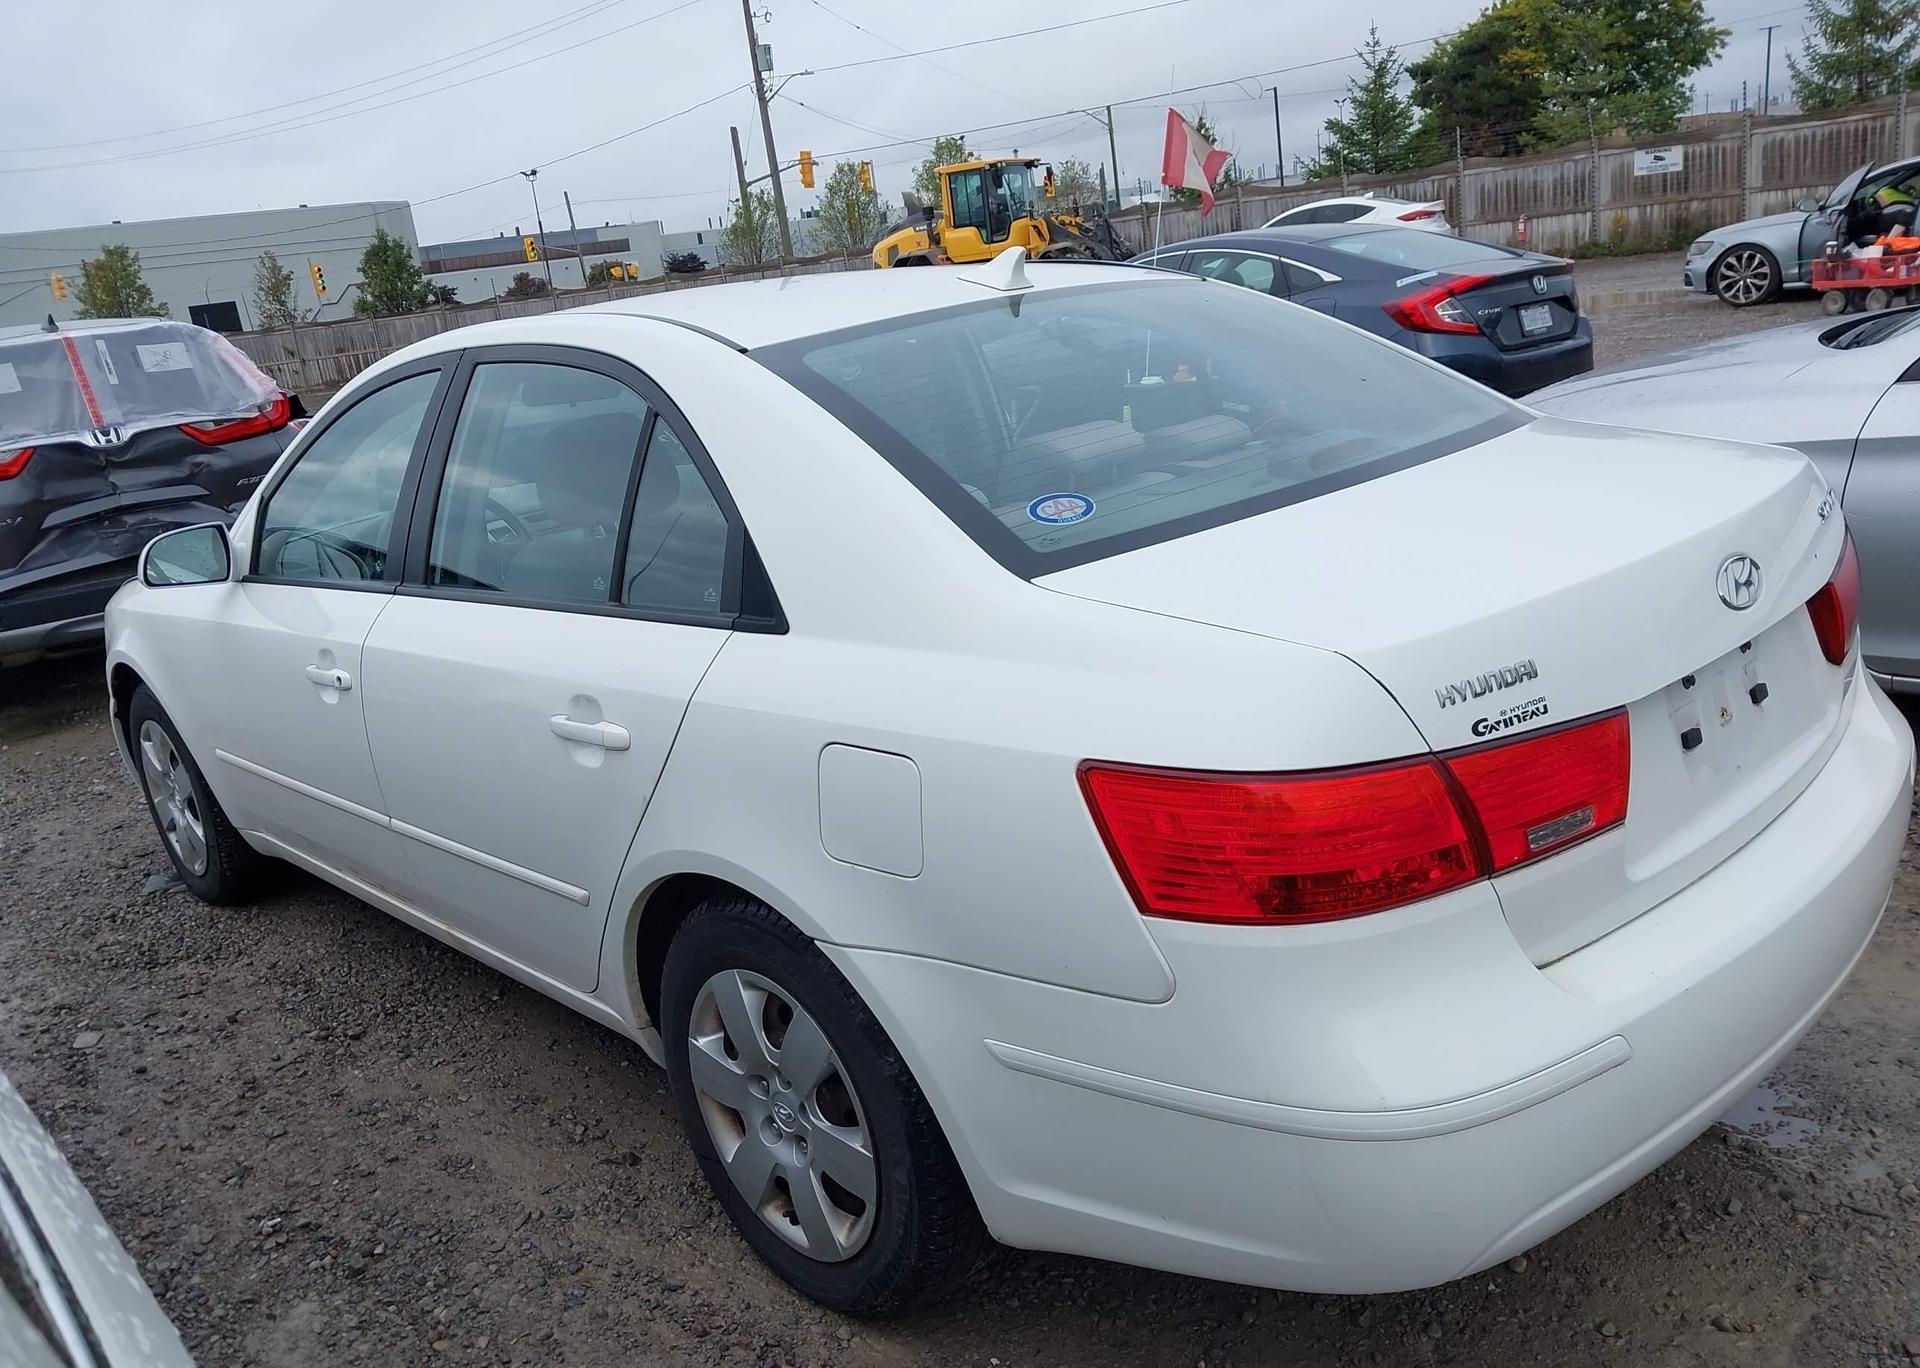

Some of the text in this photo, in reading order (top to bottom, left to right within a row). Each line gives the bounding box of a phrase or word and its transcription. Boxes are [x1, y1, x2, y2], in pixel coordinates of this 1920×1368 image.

[1477, 306, 1502, 316] CIVIC
[1435, 659, 1539, 709] HYUNDAI
[1509, 696, 1546, 714] HYUNDAI
